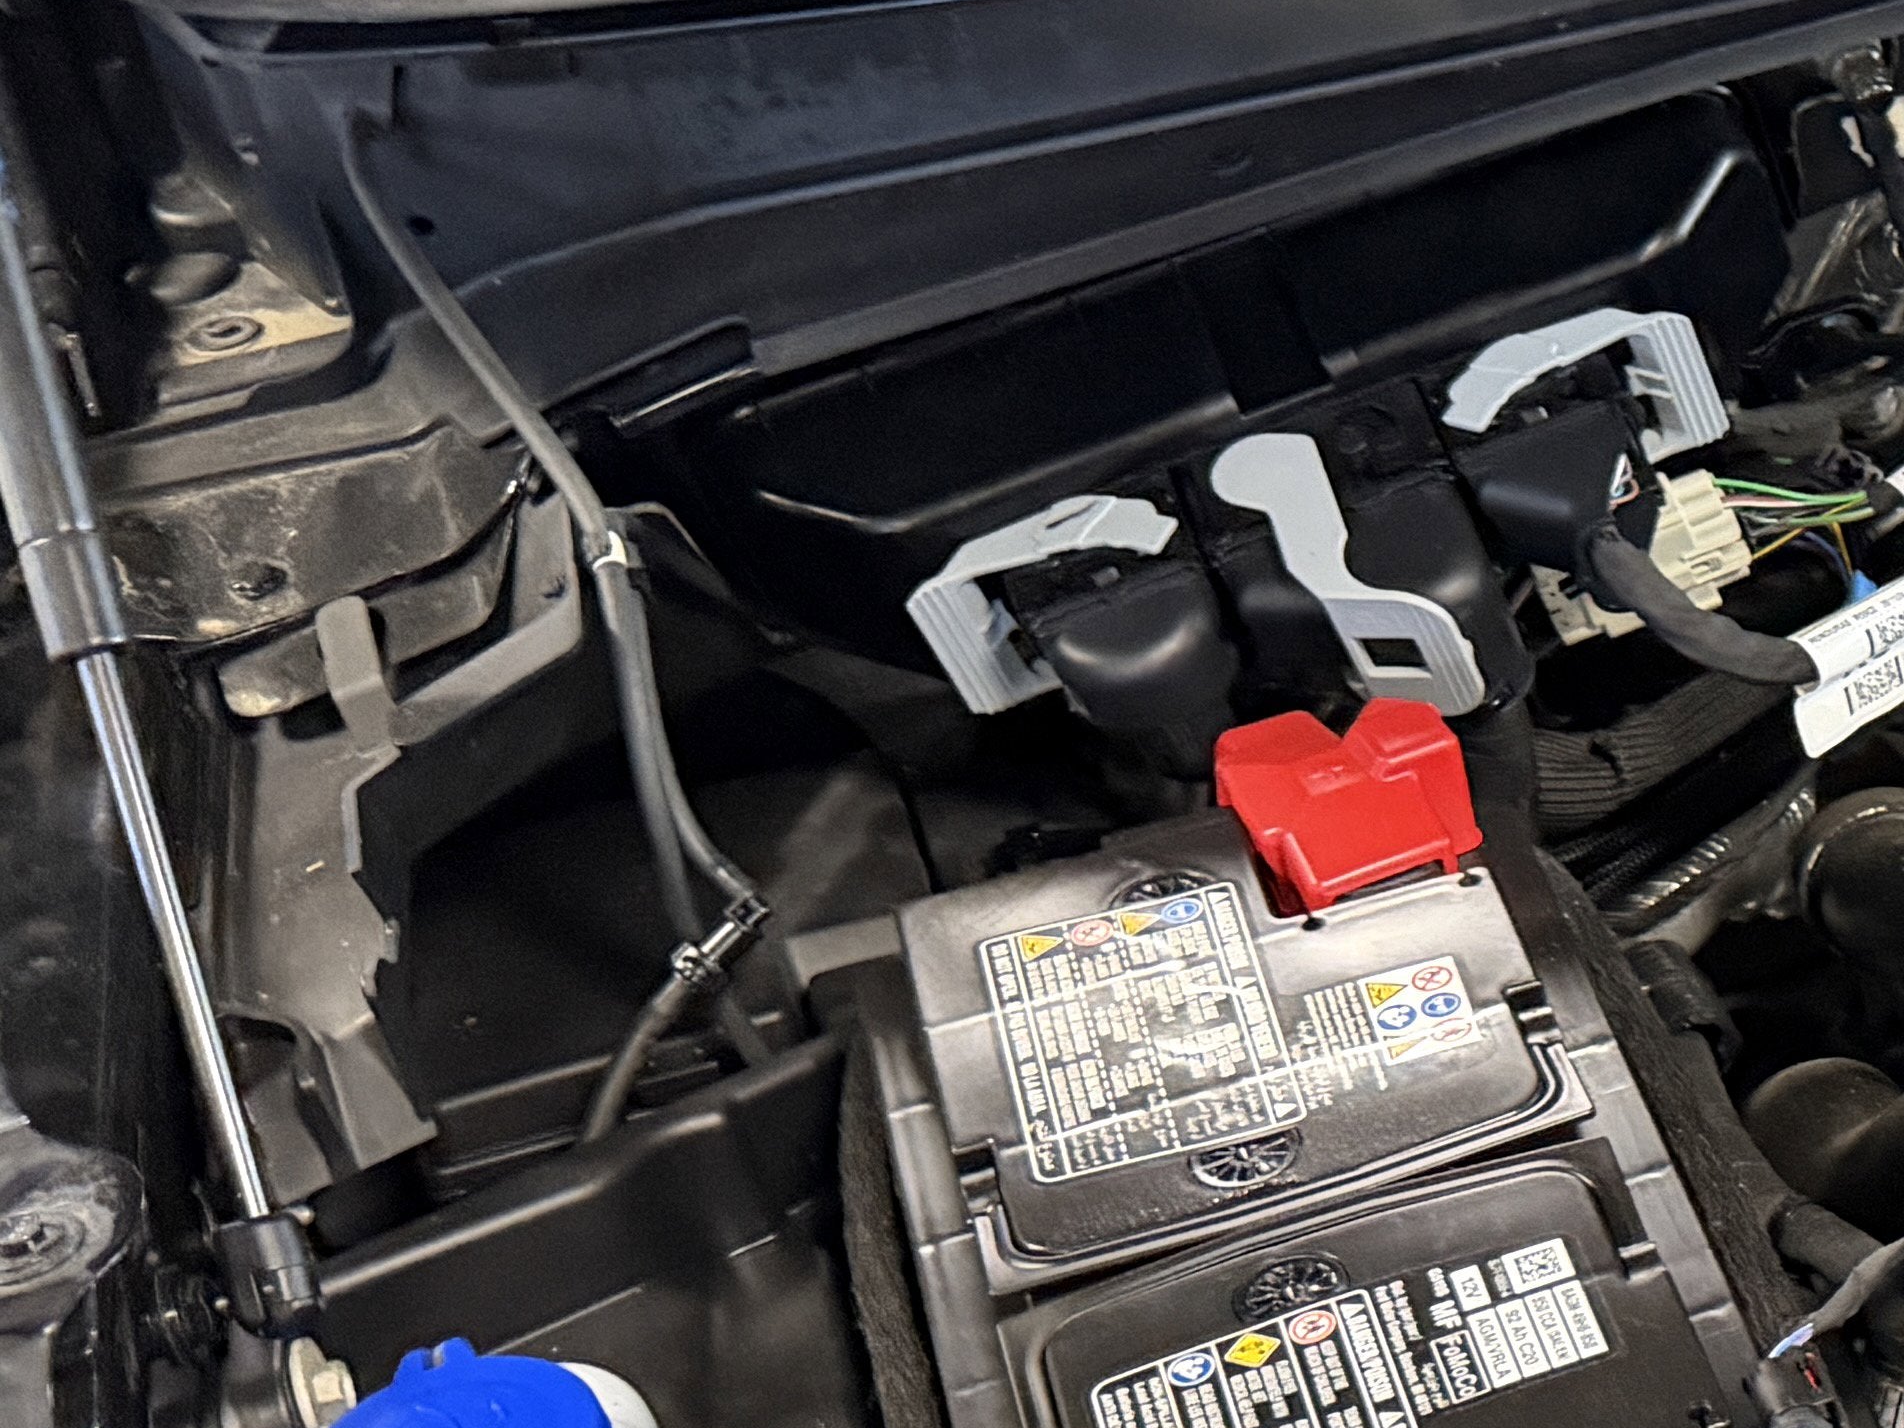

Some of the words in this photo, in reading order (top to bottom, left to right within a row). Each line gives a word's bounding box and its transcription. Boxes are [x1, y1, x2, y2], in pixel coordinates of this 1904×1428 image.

[1460, 1277, 1482, 1298] 12V
[1429, 1299, 1463, 1329] MF
[1511, 1325, 1528, 1341] Ah
[1475, 1318, 1512, 1379] AGM/VRLA
[1518, 1342, 1540, 1366] C20
[1435, 1334, 1482, 1399] FoMoCo
